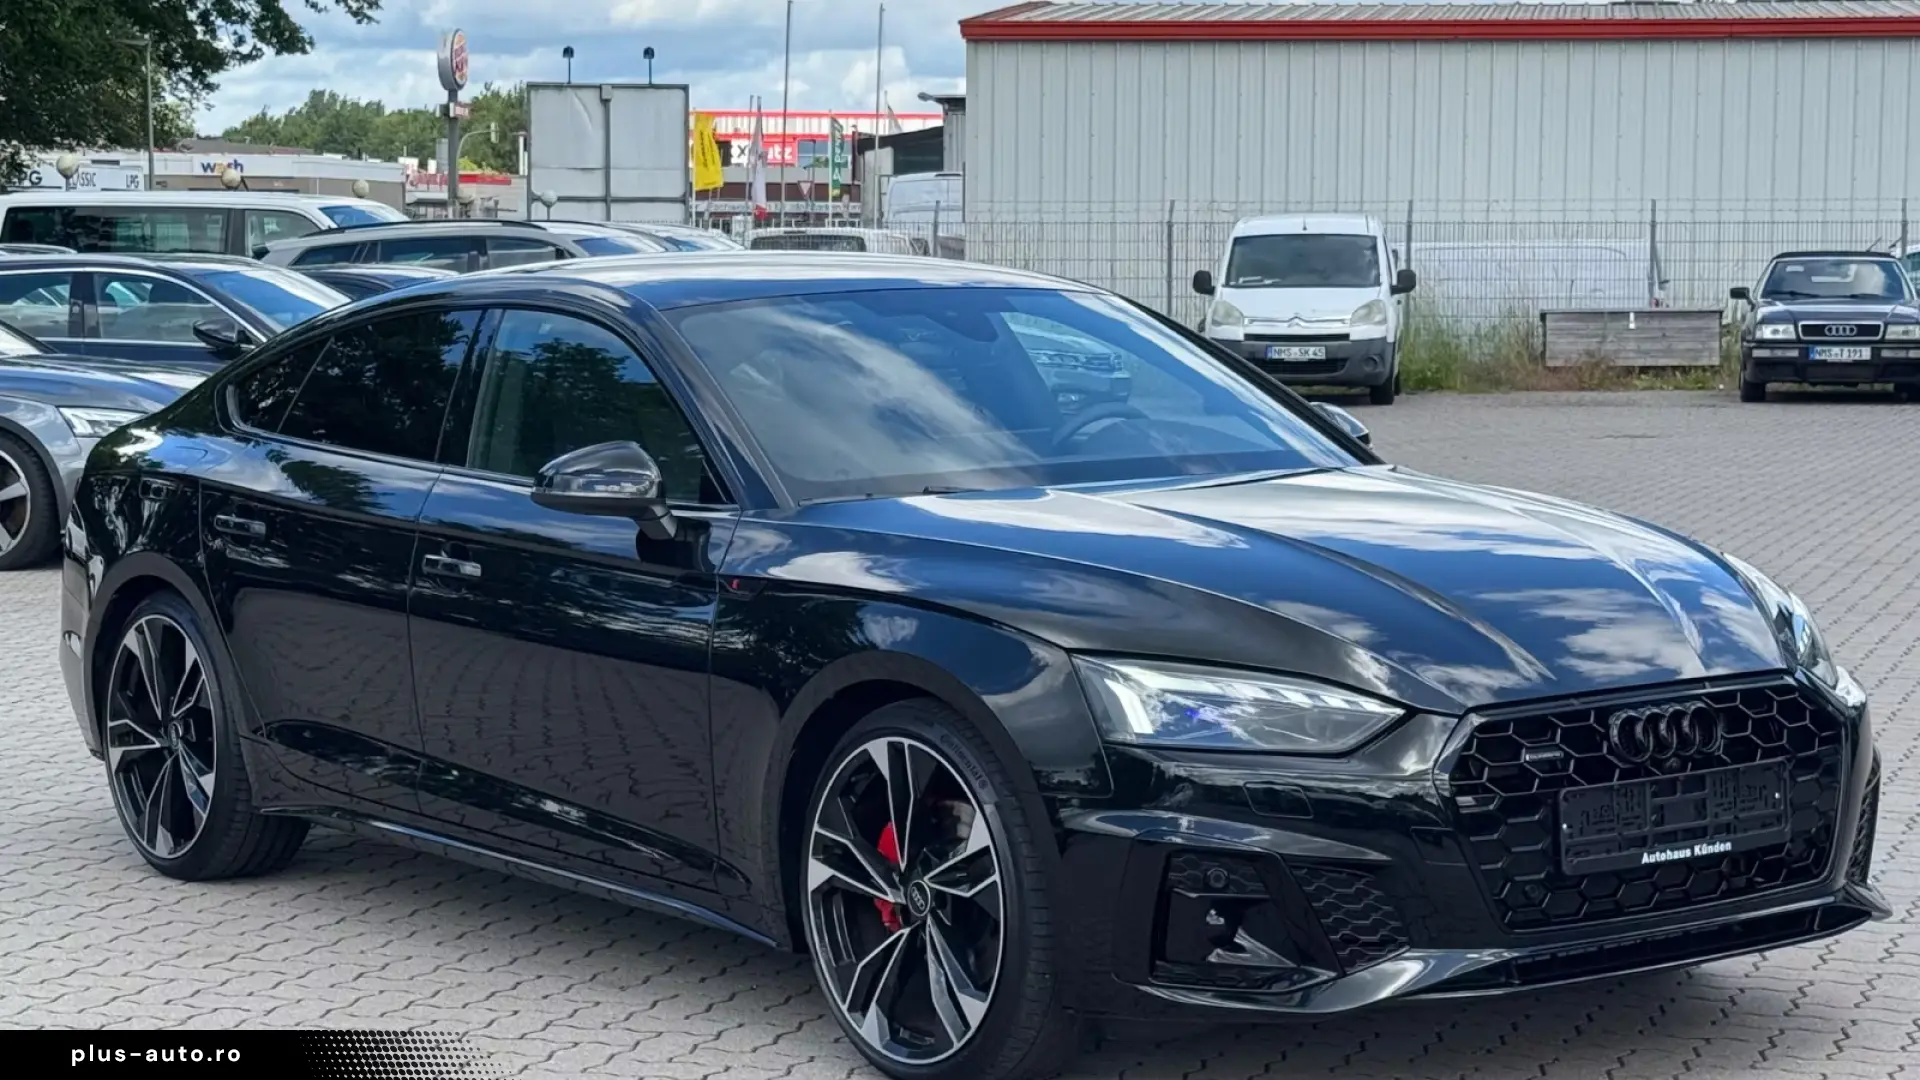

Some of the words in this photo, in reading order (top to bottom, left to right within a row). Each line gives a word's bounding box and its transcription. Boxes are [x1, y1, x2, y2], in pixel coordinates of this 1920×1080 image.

[125, 174, 140, 189] LPG
[1641, 848, 1692, 865] Autohaus
[1693, 840, 1733, 857] Künden
